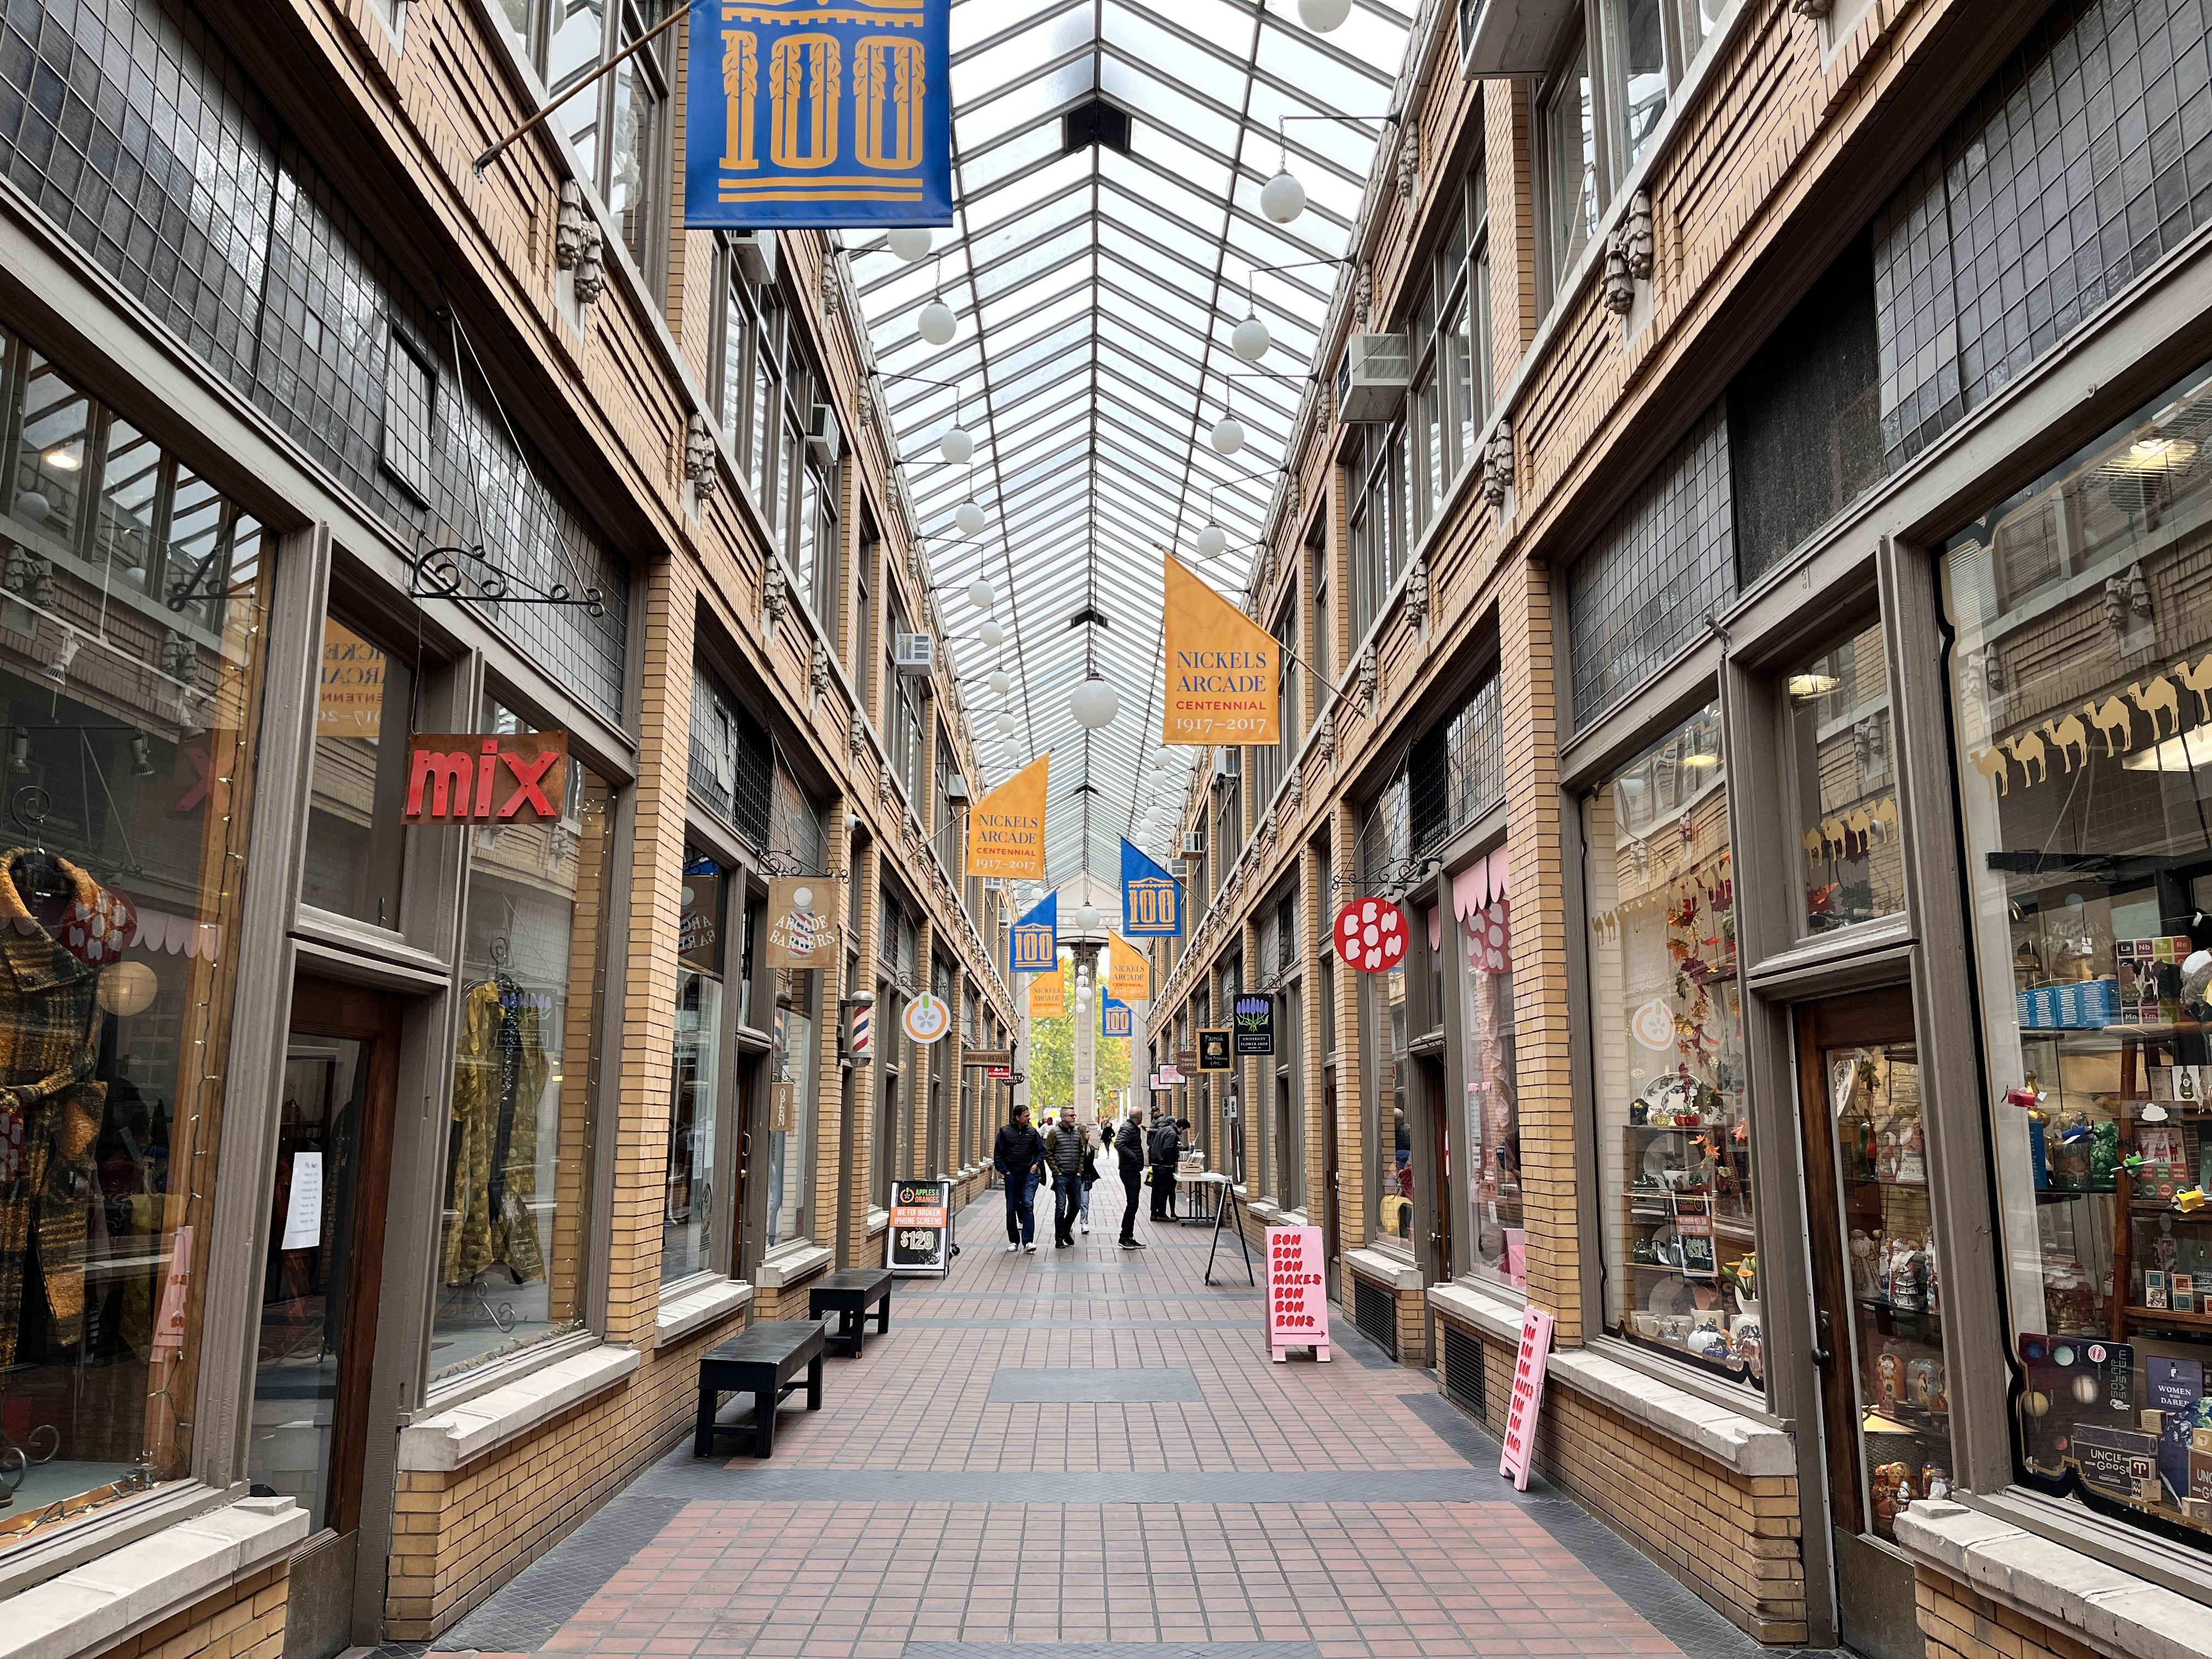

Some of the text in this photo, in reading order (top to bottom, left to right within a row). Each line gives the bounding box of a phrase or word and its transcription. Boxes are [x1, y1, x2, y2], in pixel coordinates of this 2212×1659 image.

[719, 30, 926, 170] 100
[1177, 651, 1267, 669] NICKELS
[1176, 675, 1266, 692] ARCADE
[1176, 701, 1267, 710] CENTENNIAL
[407, 740, 560, 817] mix
[979, 814, 1038, 828] NICKELS
[977, 831, 1037, 844] ARCADE
[977, 848, 1036, 856] CENTENNIAL
[1128, 889, 1175, 923] 100
[775, 915, 828, 932] ARCADE
[769, 929, 836, 949] BARBERS
[1015, 933, 1053, 961] 100
[1105, 1012, 1129, 1030] 100
[988, 1055, 1009, 1063] REPAIR
[777, 1088, 786, 1127] OPEN
[900, 1231, 934, 1250] $129
[1273, 1234, 1301, 1245] BON
[1273, 1247, 1301, 1259] BON
[1274, 1261, 1302, 1272] BON
[1273, 1274, 1322, 1285] MAKES
[1275, 1288, 1304, 1299] BON
[1275, 1301, 1304, 1312] BON
[1276, 1315, 1314, 1327] BONS
[2158, 1385, 2191, 1396] WOMEN
[2091, 1448, 2121, 1463] UNCLE
[2097, 1461, 2130, 1475] GOOSE
